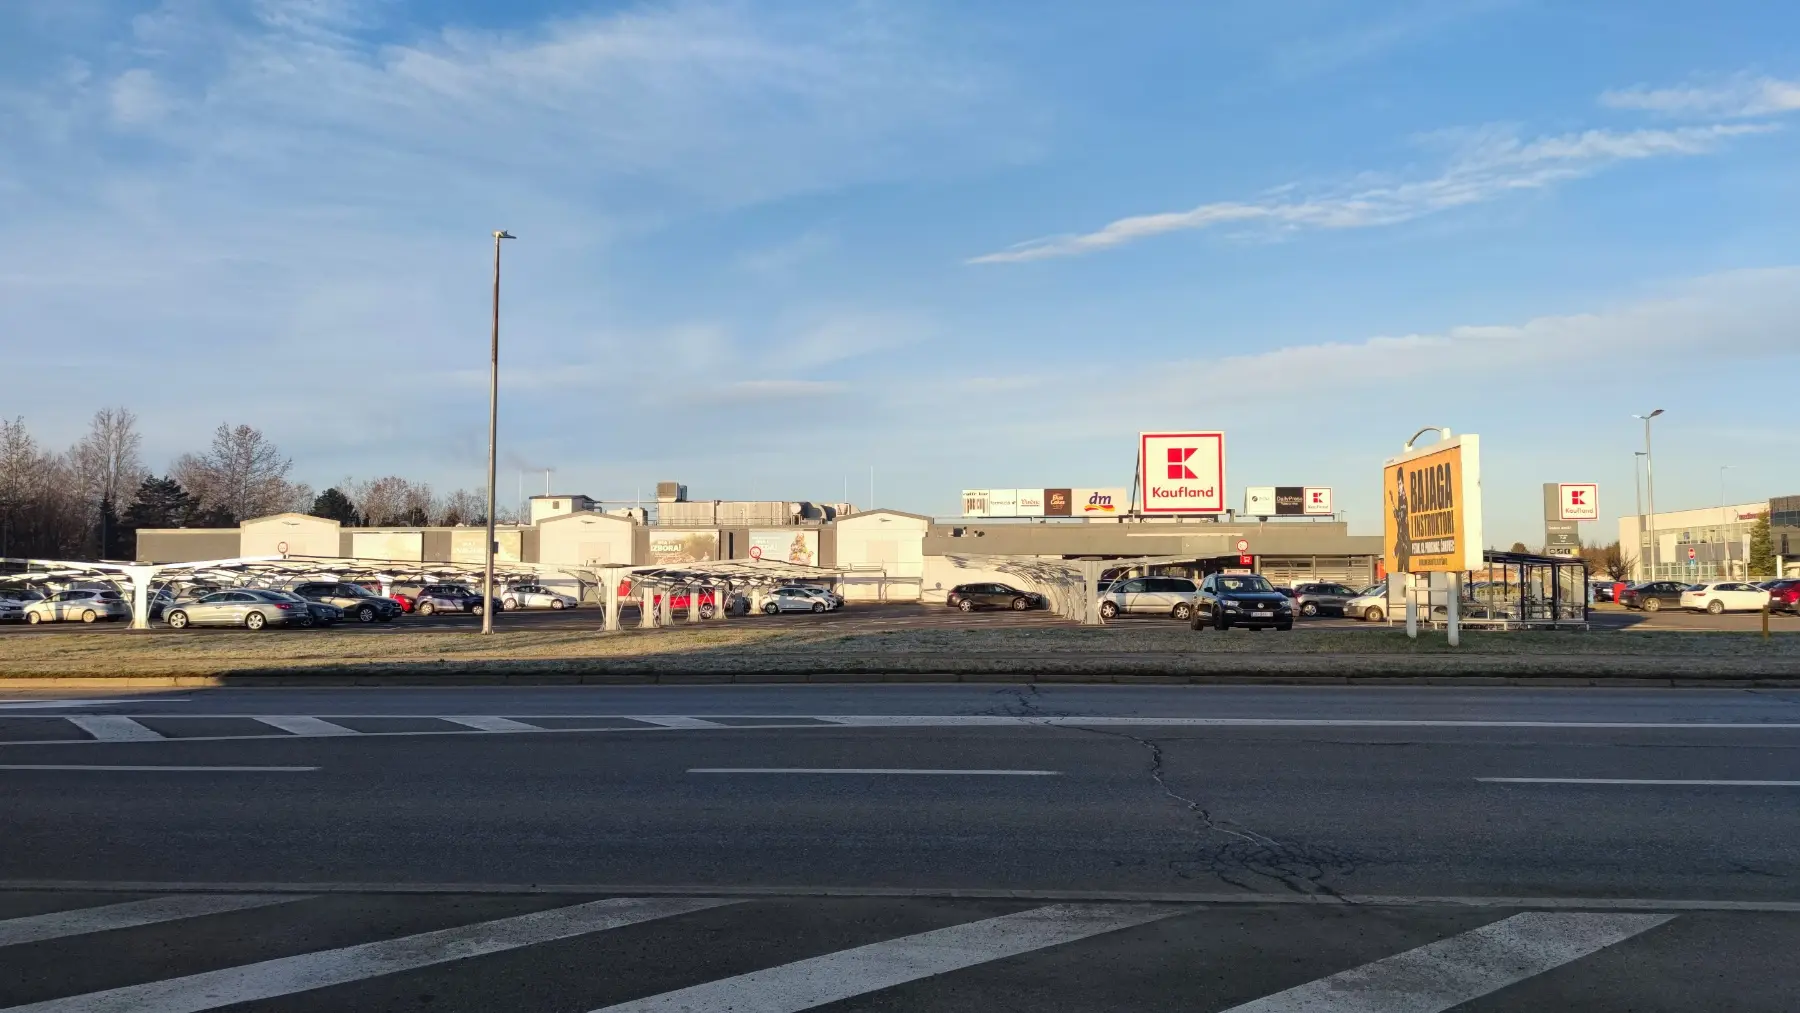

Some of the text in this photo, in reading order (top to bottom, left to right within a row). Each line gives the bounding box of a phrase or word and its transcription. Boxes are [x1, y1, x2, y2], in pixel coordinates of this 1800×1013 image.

[1089, 491, 1112, 505] dm
[1152, 486, 1214, 498] Kaufland
[1410, 462, 1454, 514] BAJAGA
[1411, 510, 1454, 538] I INSTRUKTORI
